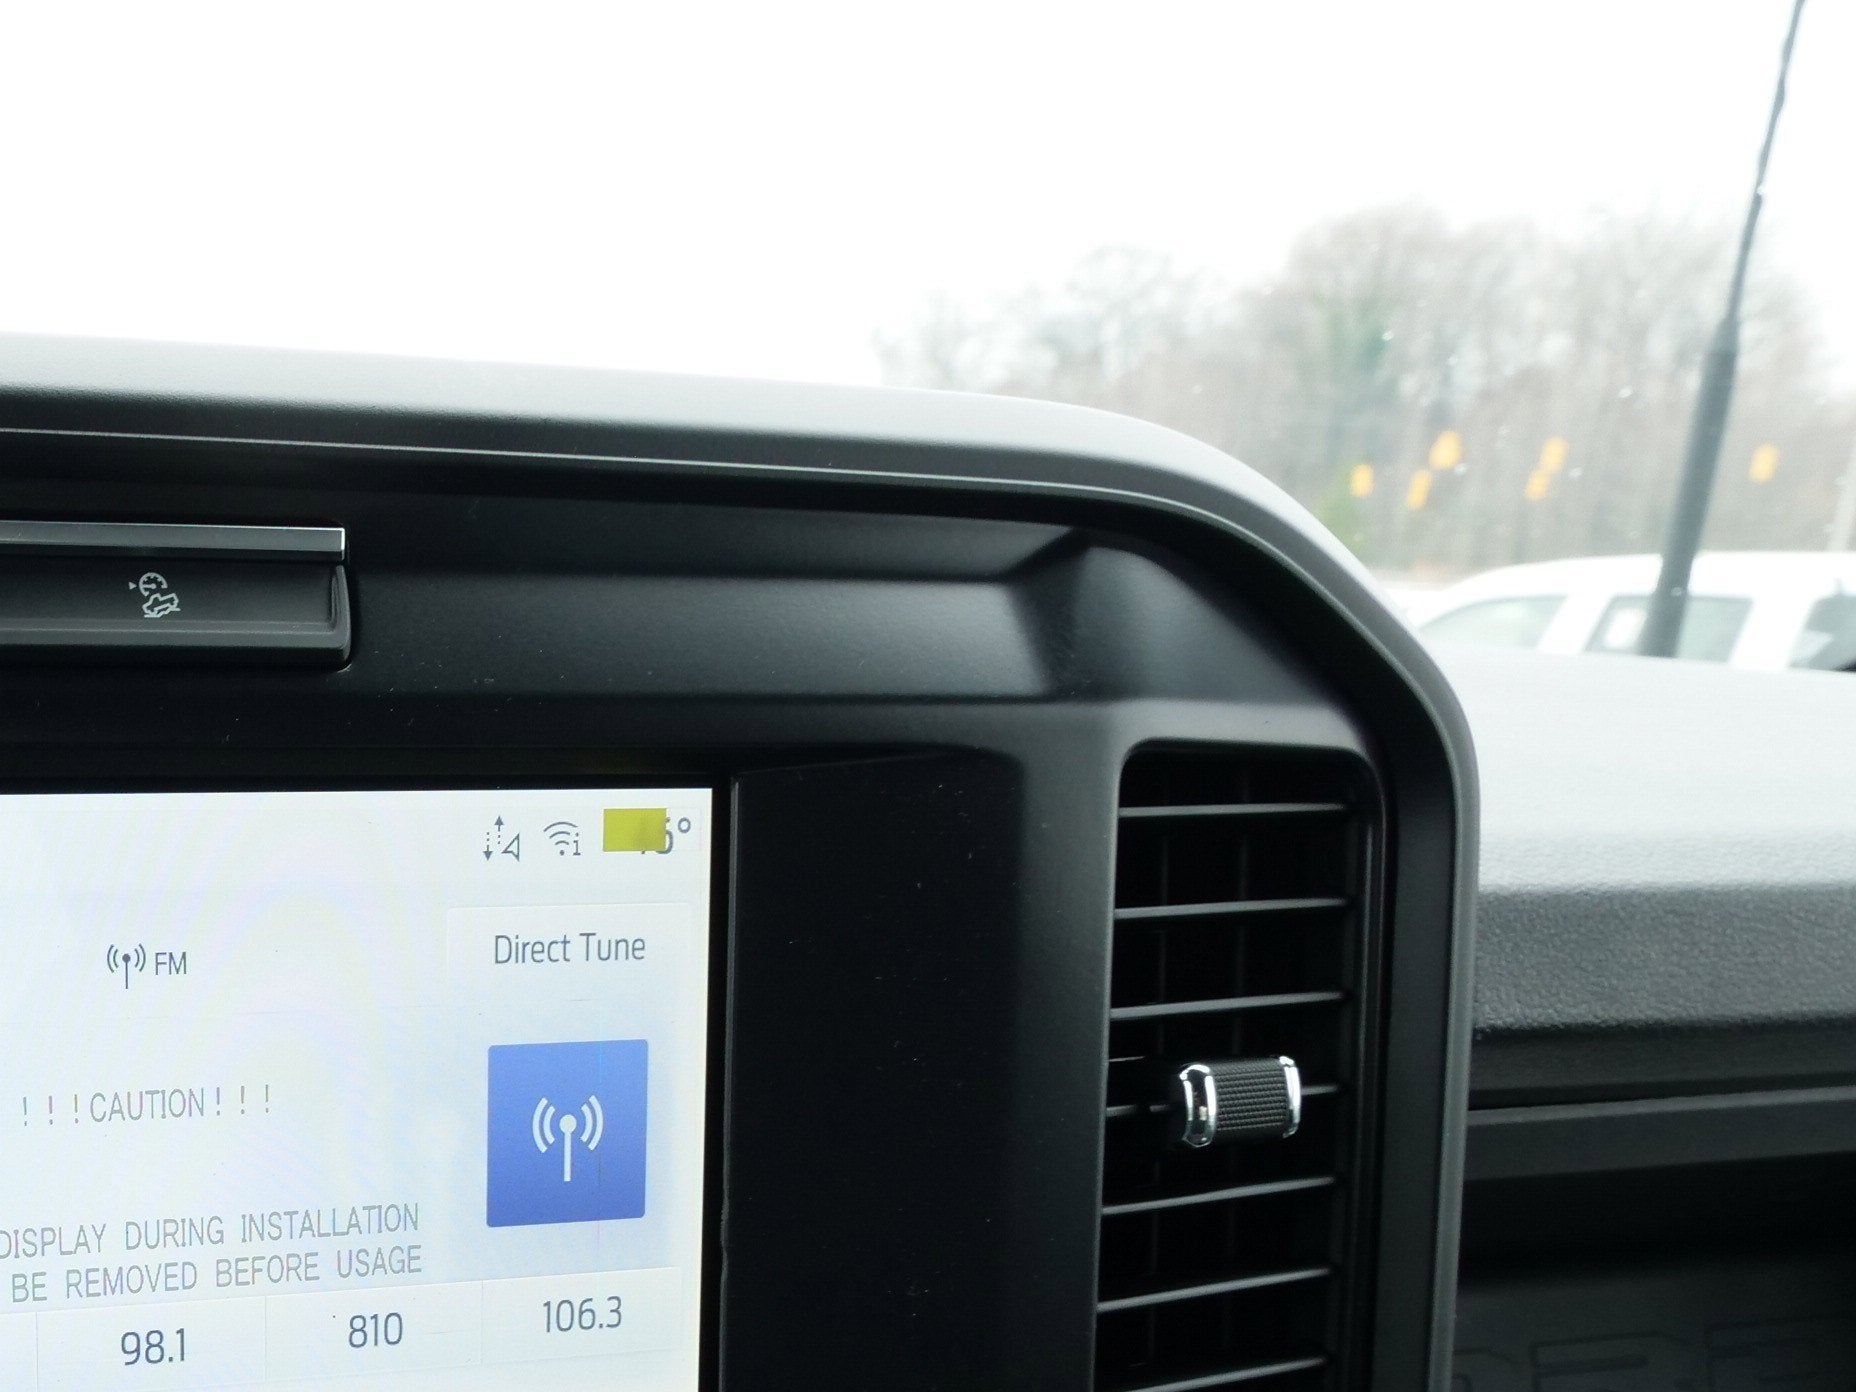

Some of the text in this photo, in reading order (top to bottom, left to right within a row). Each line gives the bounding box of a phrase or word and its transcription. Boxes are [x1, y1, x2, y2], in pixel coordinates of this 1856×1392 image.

[154, 951, 187, 976] FM
[494, 932, 646, 965] Direct Tune
[124, 1215, 226, 1251] DURING
[241, 1202, 420, 1244] INSTALLATION
[11, 1272, 48, 1303] BE
[65, 1261, 198, 1299] REMOVED
[214, 1251, 321, 1288] BEFORE
[336, 1245, 423, 1279] USAGE
[348, 1311, 404, 1349] 810
[542, 1295, 624, 1334] 106.3
[120, 1327, 187, 1366] 98.1
